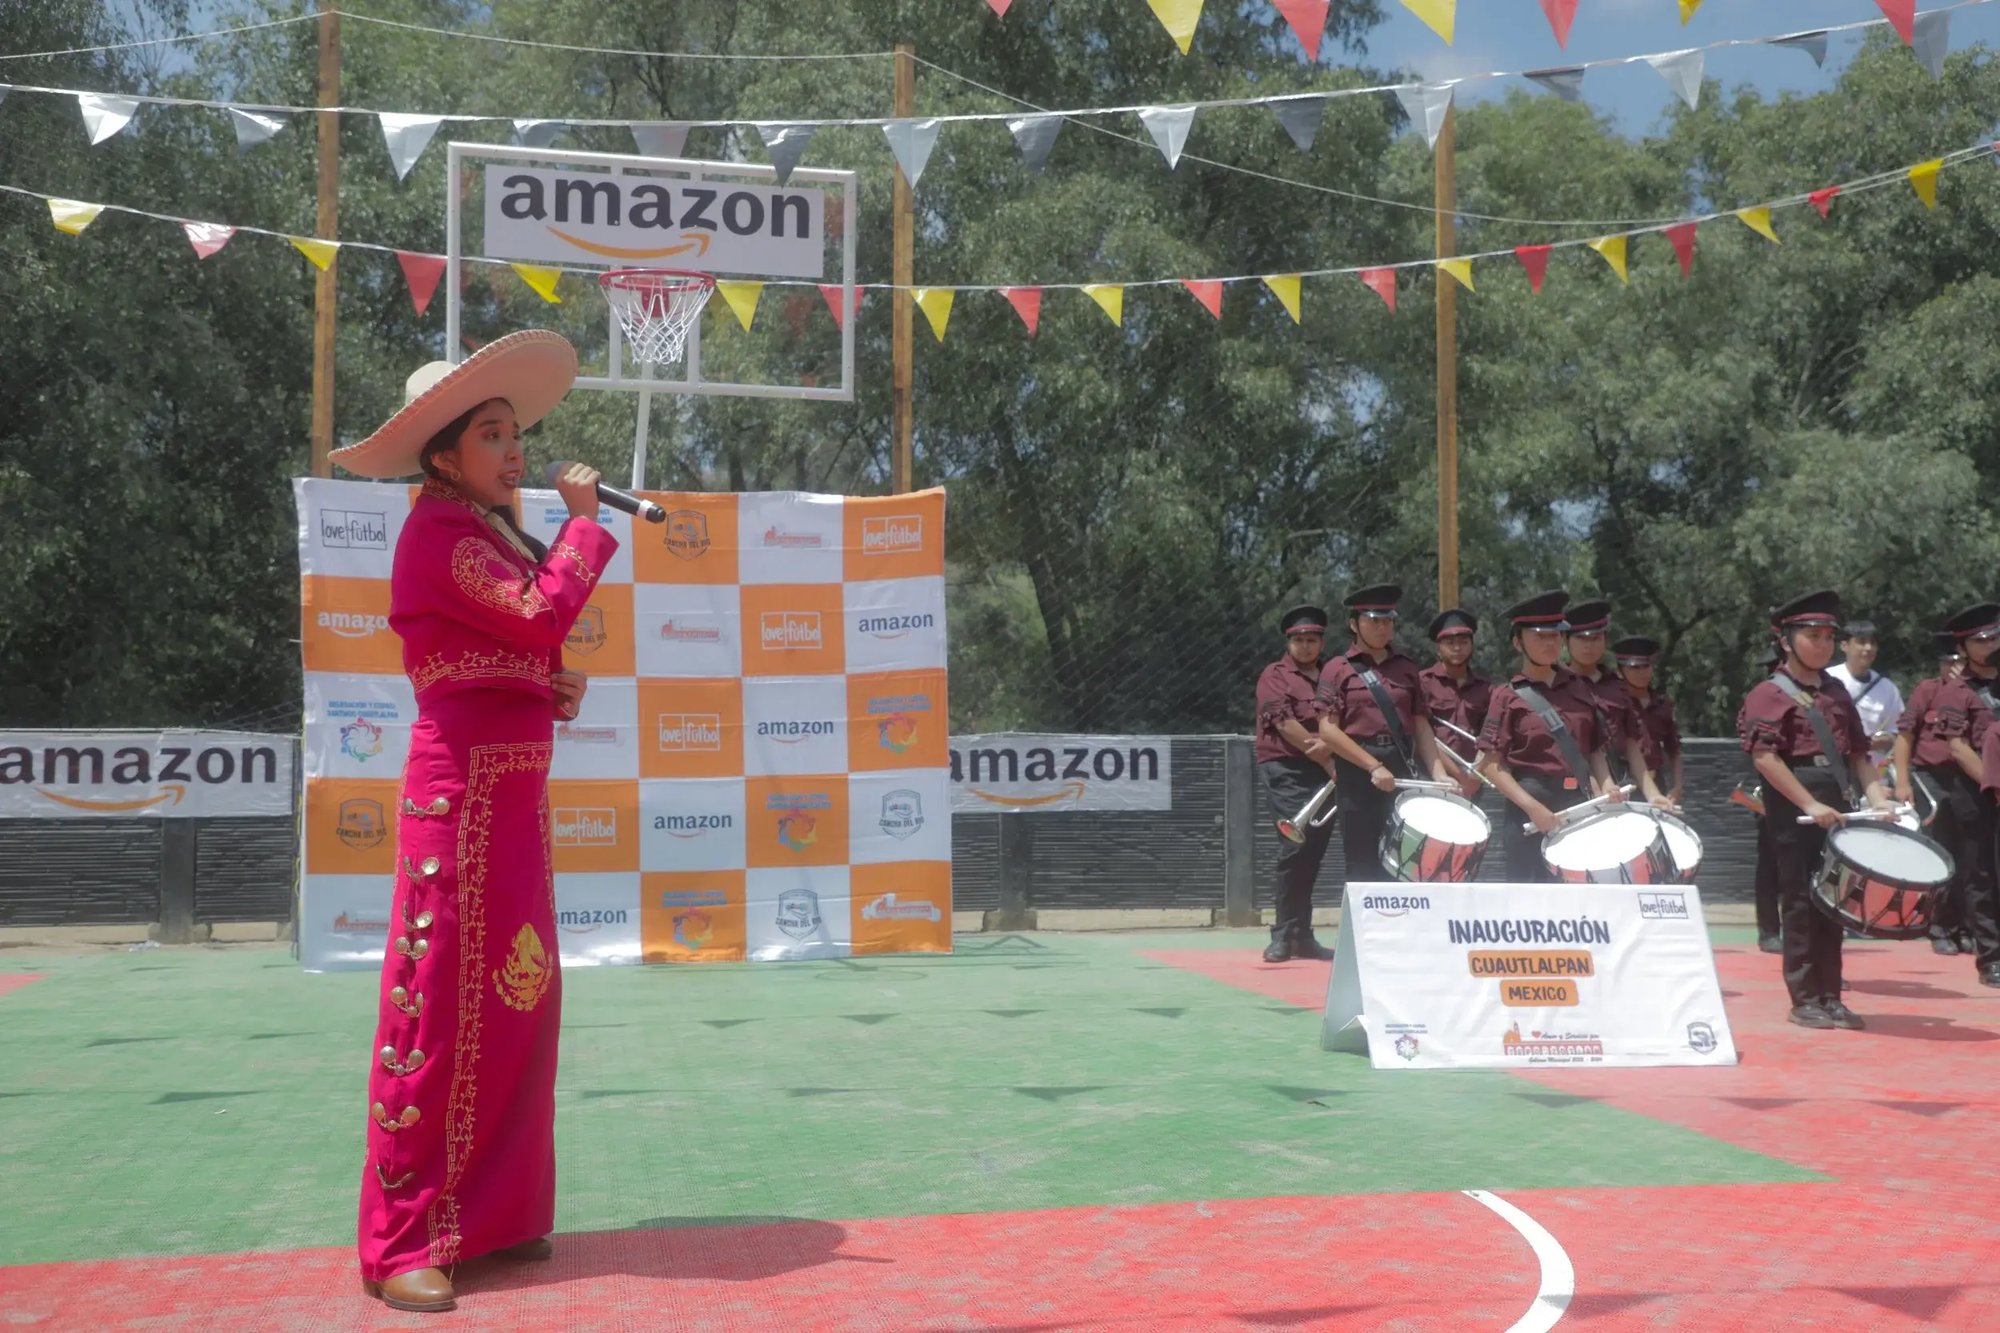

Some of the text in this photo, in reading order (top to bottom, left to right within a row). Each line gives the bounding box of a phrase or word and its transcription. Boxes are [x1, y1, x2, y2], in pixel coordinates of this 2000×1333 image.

[500, 174, 811, 239] amazon
[321, 517, 345, 540] love
[318, 612, 388, 629] amazo
[859, 613, 933, 633] amazon
[757, 719, 834, 736] amazon
[0, 746, 277, 784] amazon
[654, 814, 732, 830] amazon
[1363, 896, 1430, 909] amazon
[556, 909, 627, 925] mazon
[1448, 915, 1610, 944] INAUGURACIÓN
[1471, 956, 1591, 974] CUAUTLALPAN
[1508, 986, 1567, 1001] MEXICO
